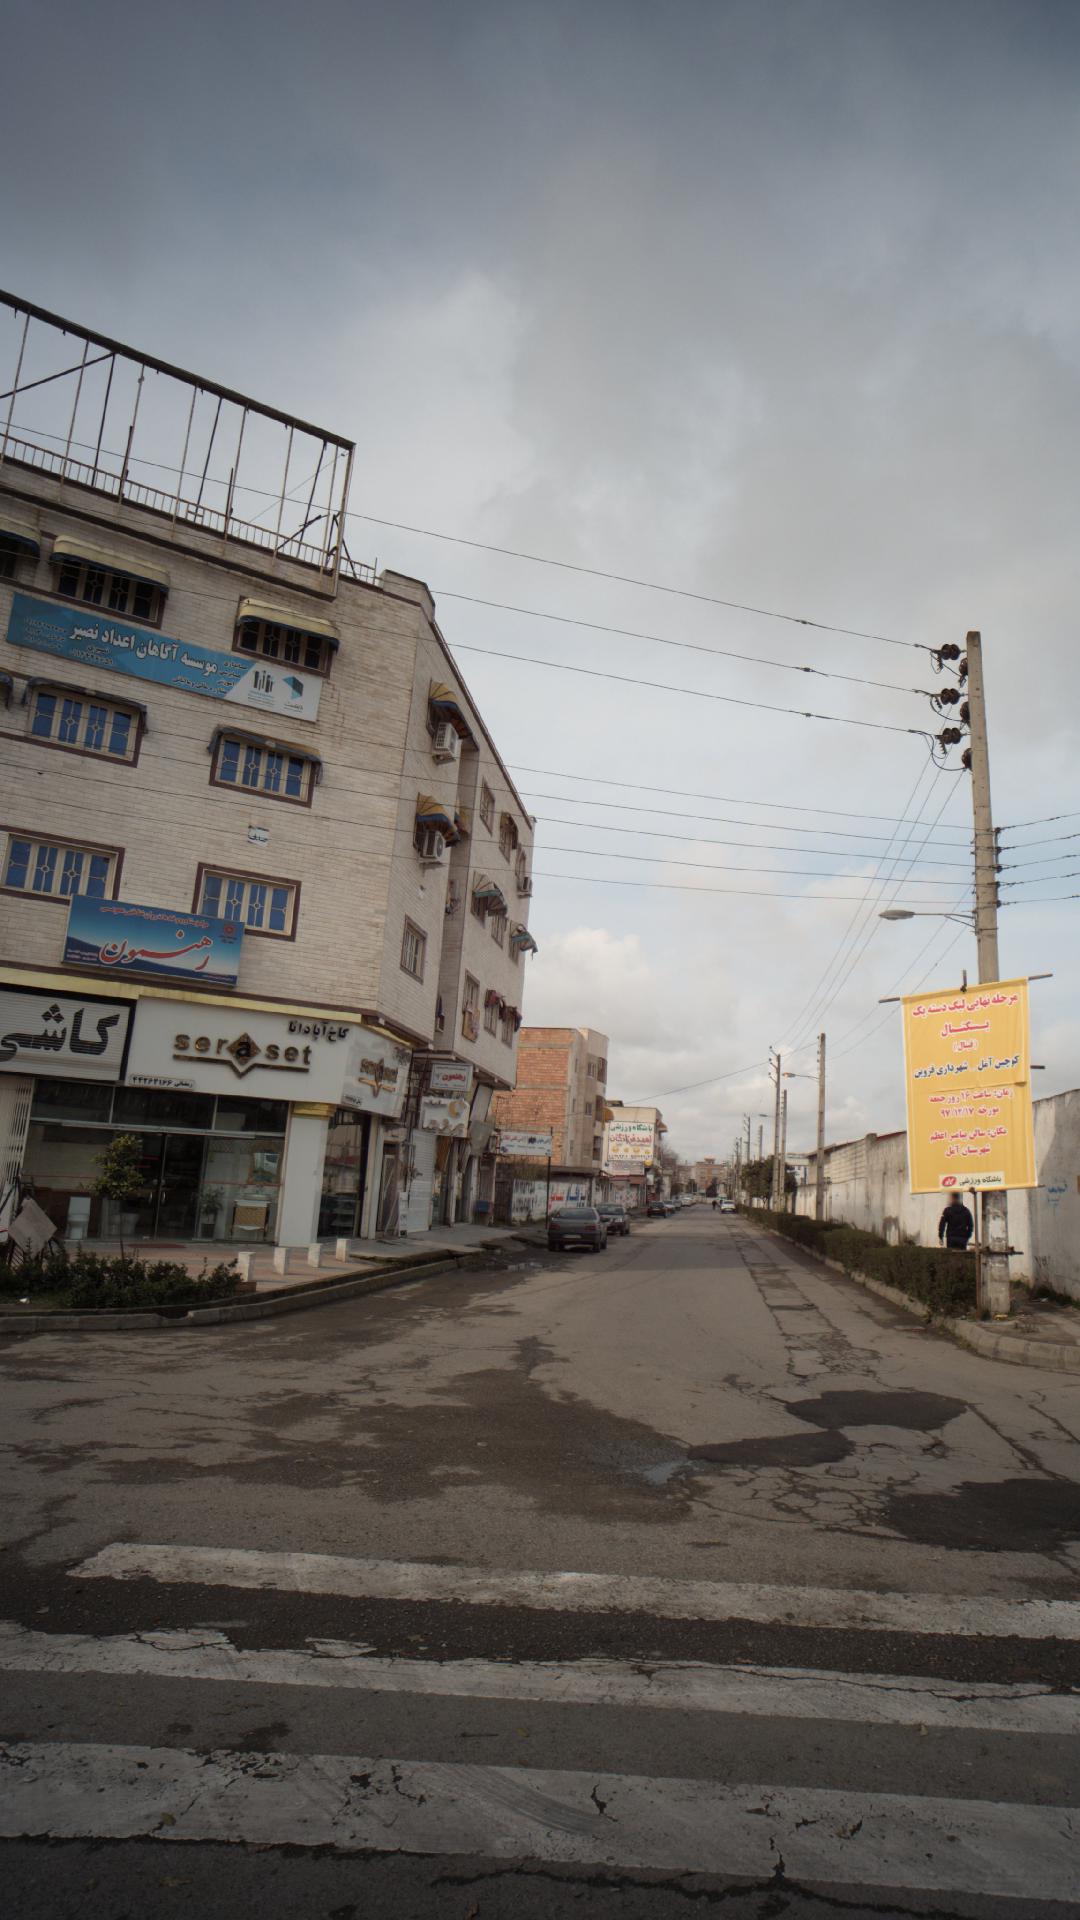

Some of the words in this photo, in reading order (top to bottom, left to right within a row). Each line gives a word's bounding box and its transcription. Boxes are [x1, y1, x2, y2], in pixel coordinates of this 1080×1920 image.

[69, 623, 99, 640] نصیر
[101, 629, 135, 650] اعداد
[136, 640, 179, 660] آگاهان
[181, 652, 218, 676] موسسه
[99, 929, 213, 972] رهنمون
[991, 993, 1018, 1005] مرحله
[928, 1004, 947, 1013] دسته
[0, 1003, 120, 1063] کاشی
[328, 1025, 350, 1042] کاخ
[174, 1033, 312, 1066] seraset
[936, 1061, 968, 1075] شهرداری
[977, 1057, 992, 1071] آمل
